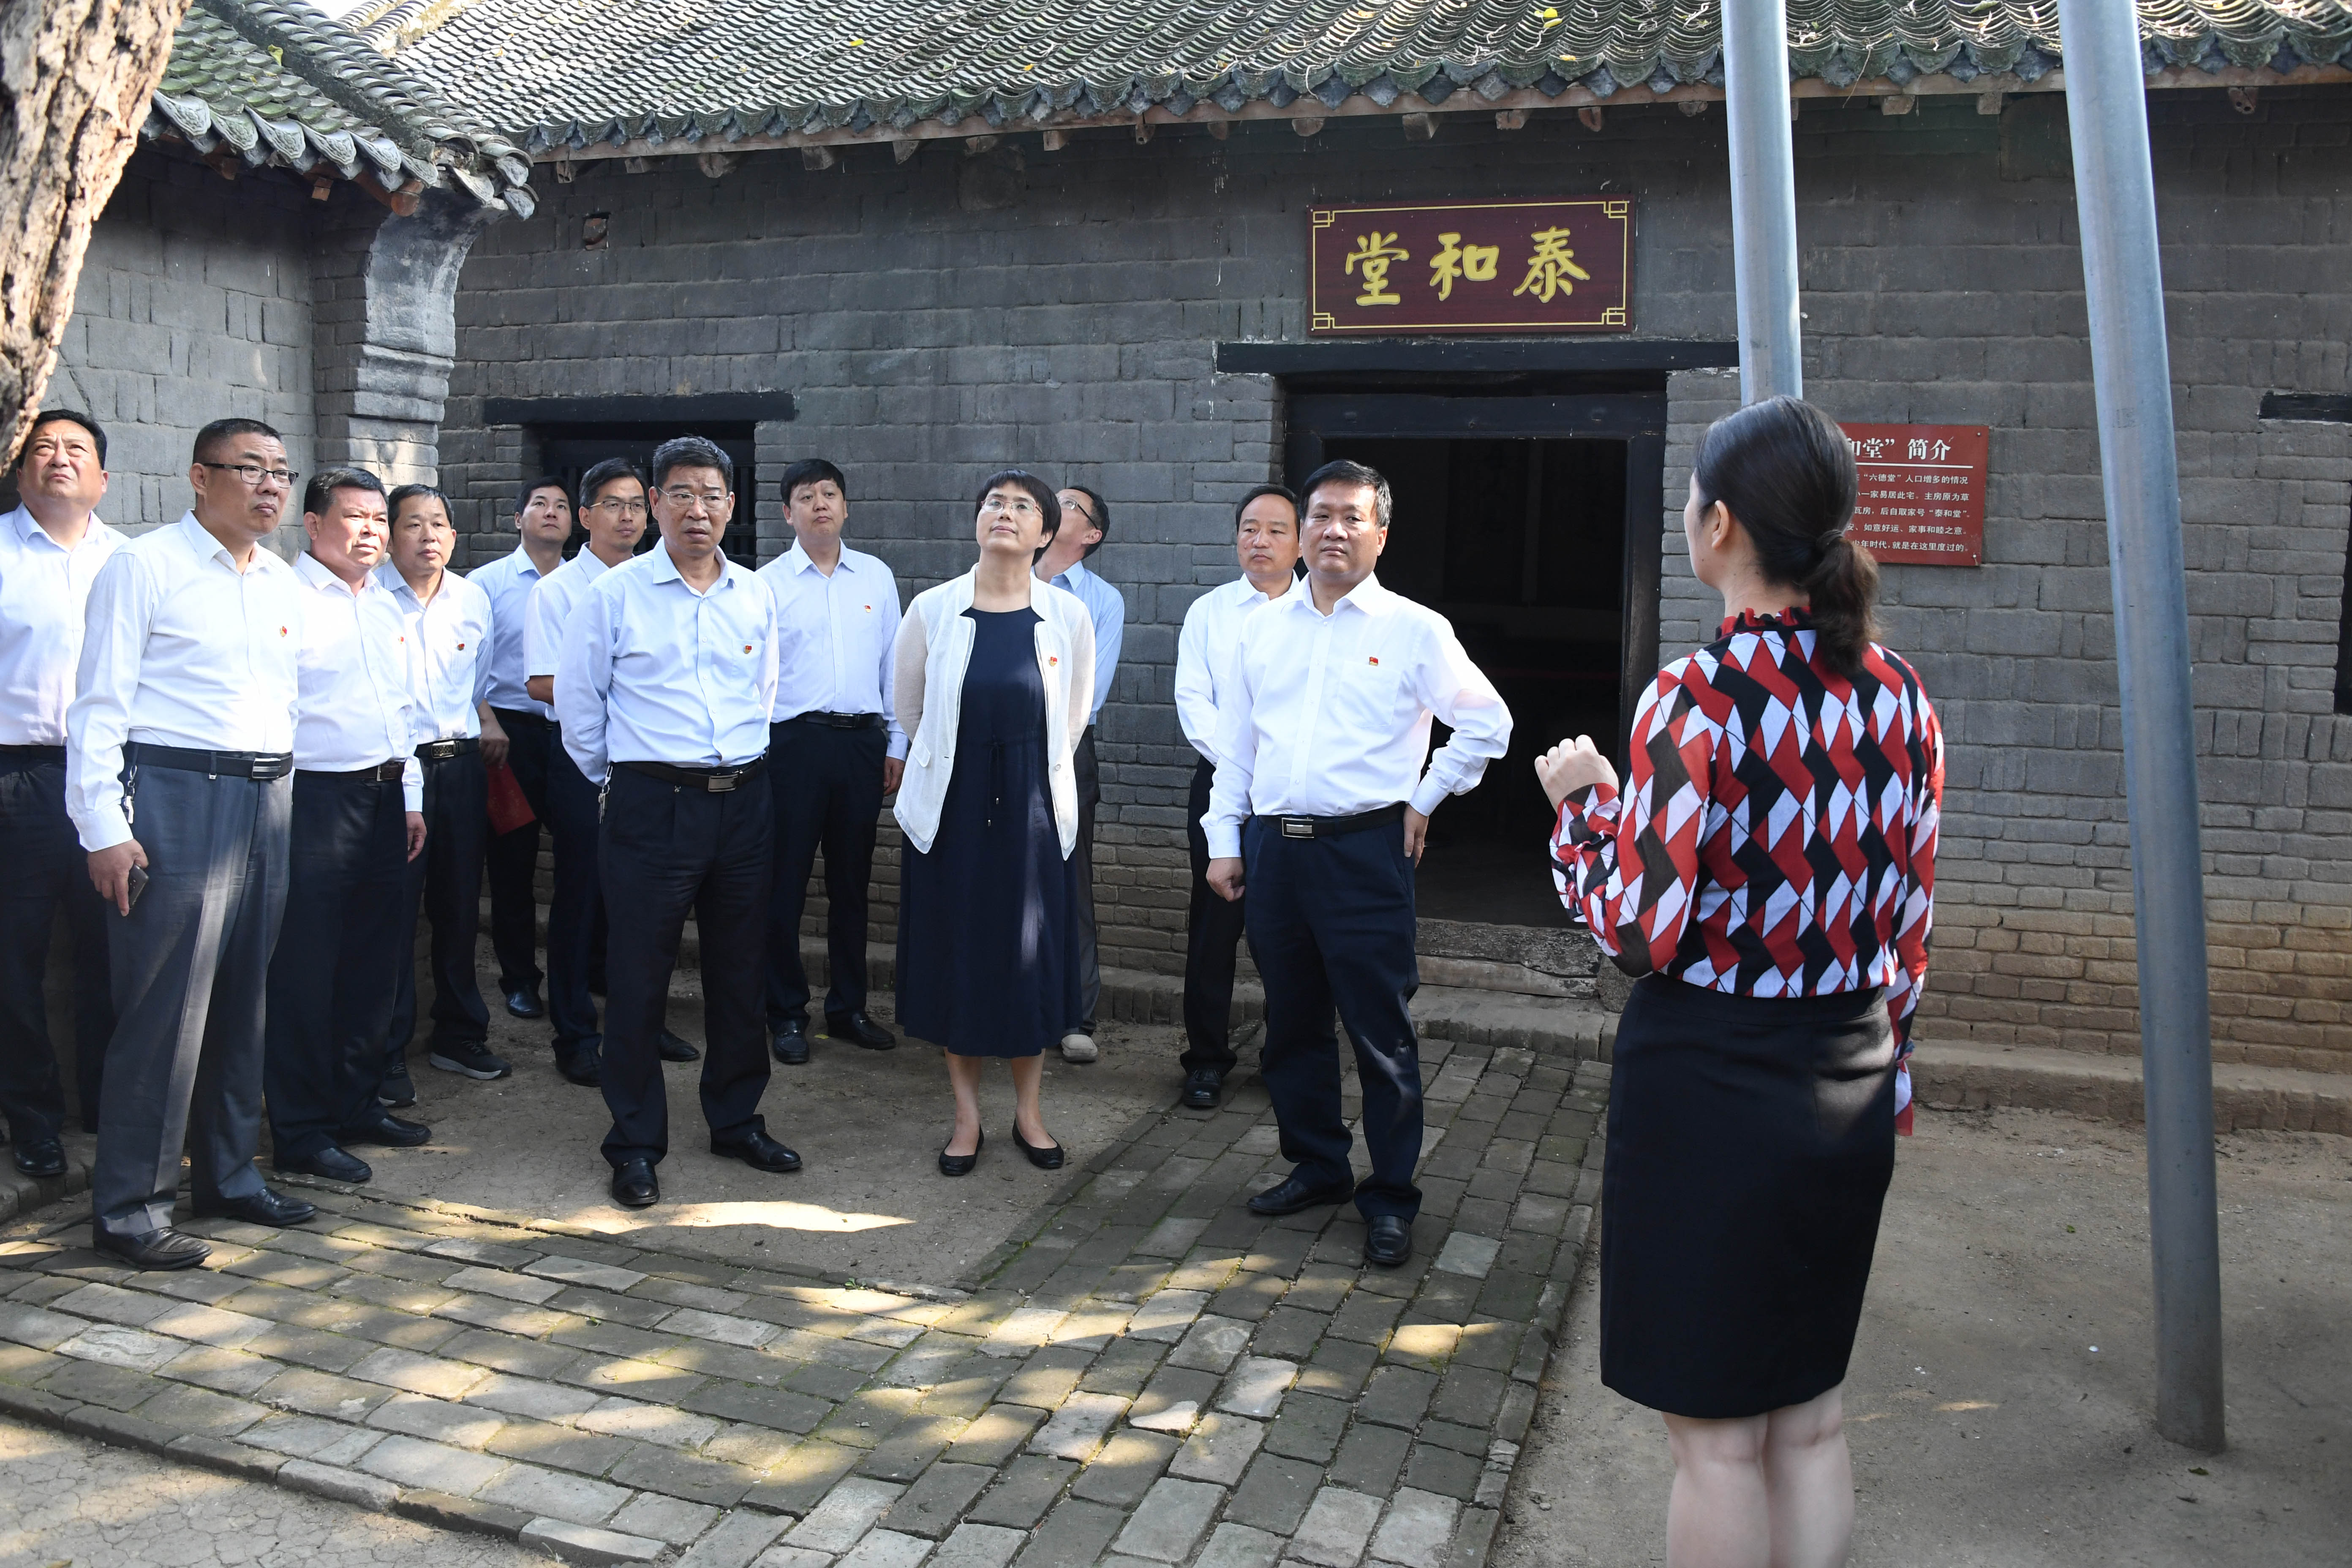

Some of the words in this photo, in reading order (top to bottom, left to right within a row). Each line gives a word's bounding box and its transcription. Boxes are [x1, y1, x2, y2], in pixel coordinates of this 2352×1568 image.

[1856, 490, 1969, 501] 一家易居此宅。主房原为草
